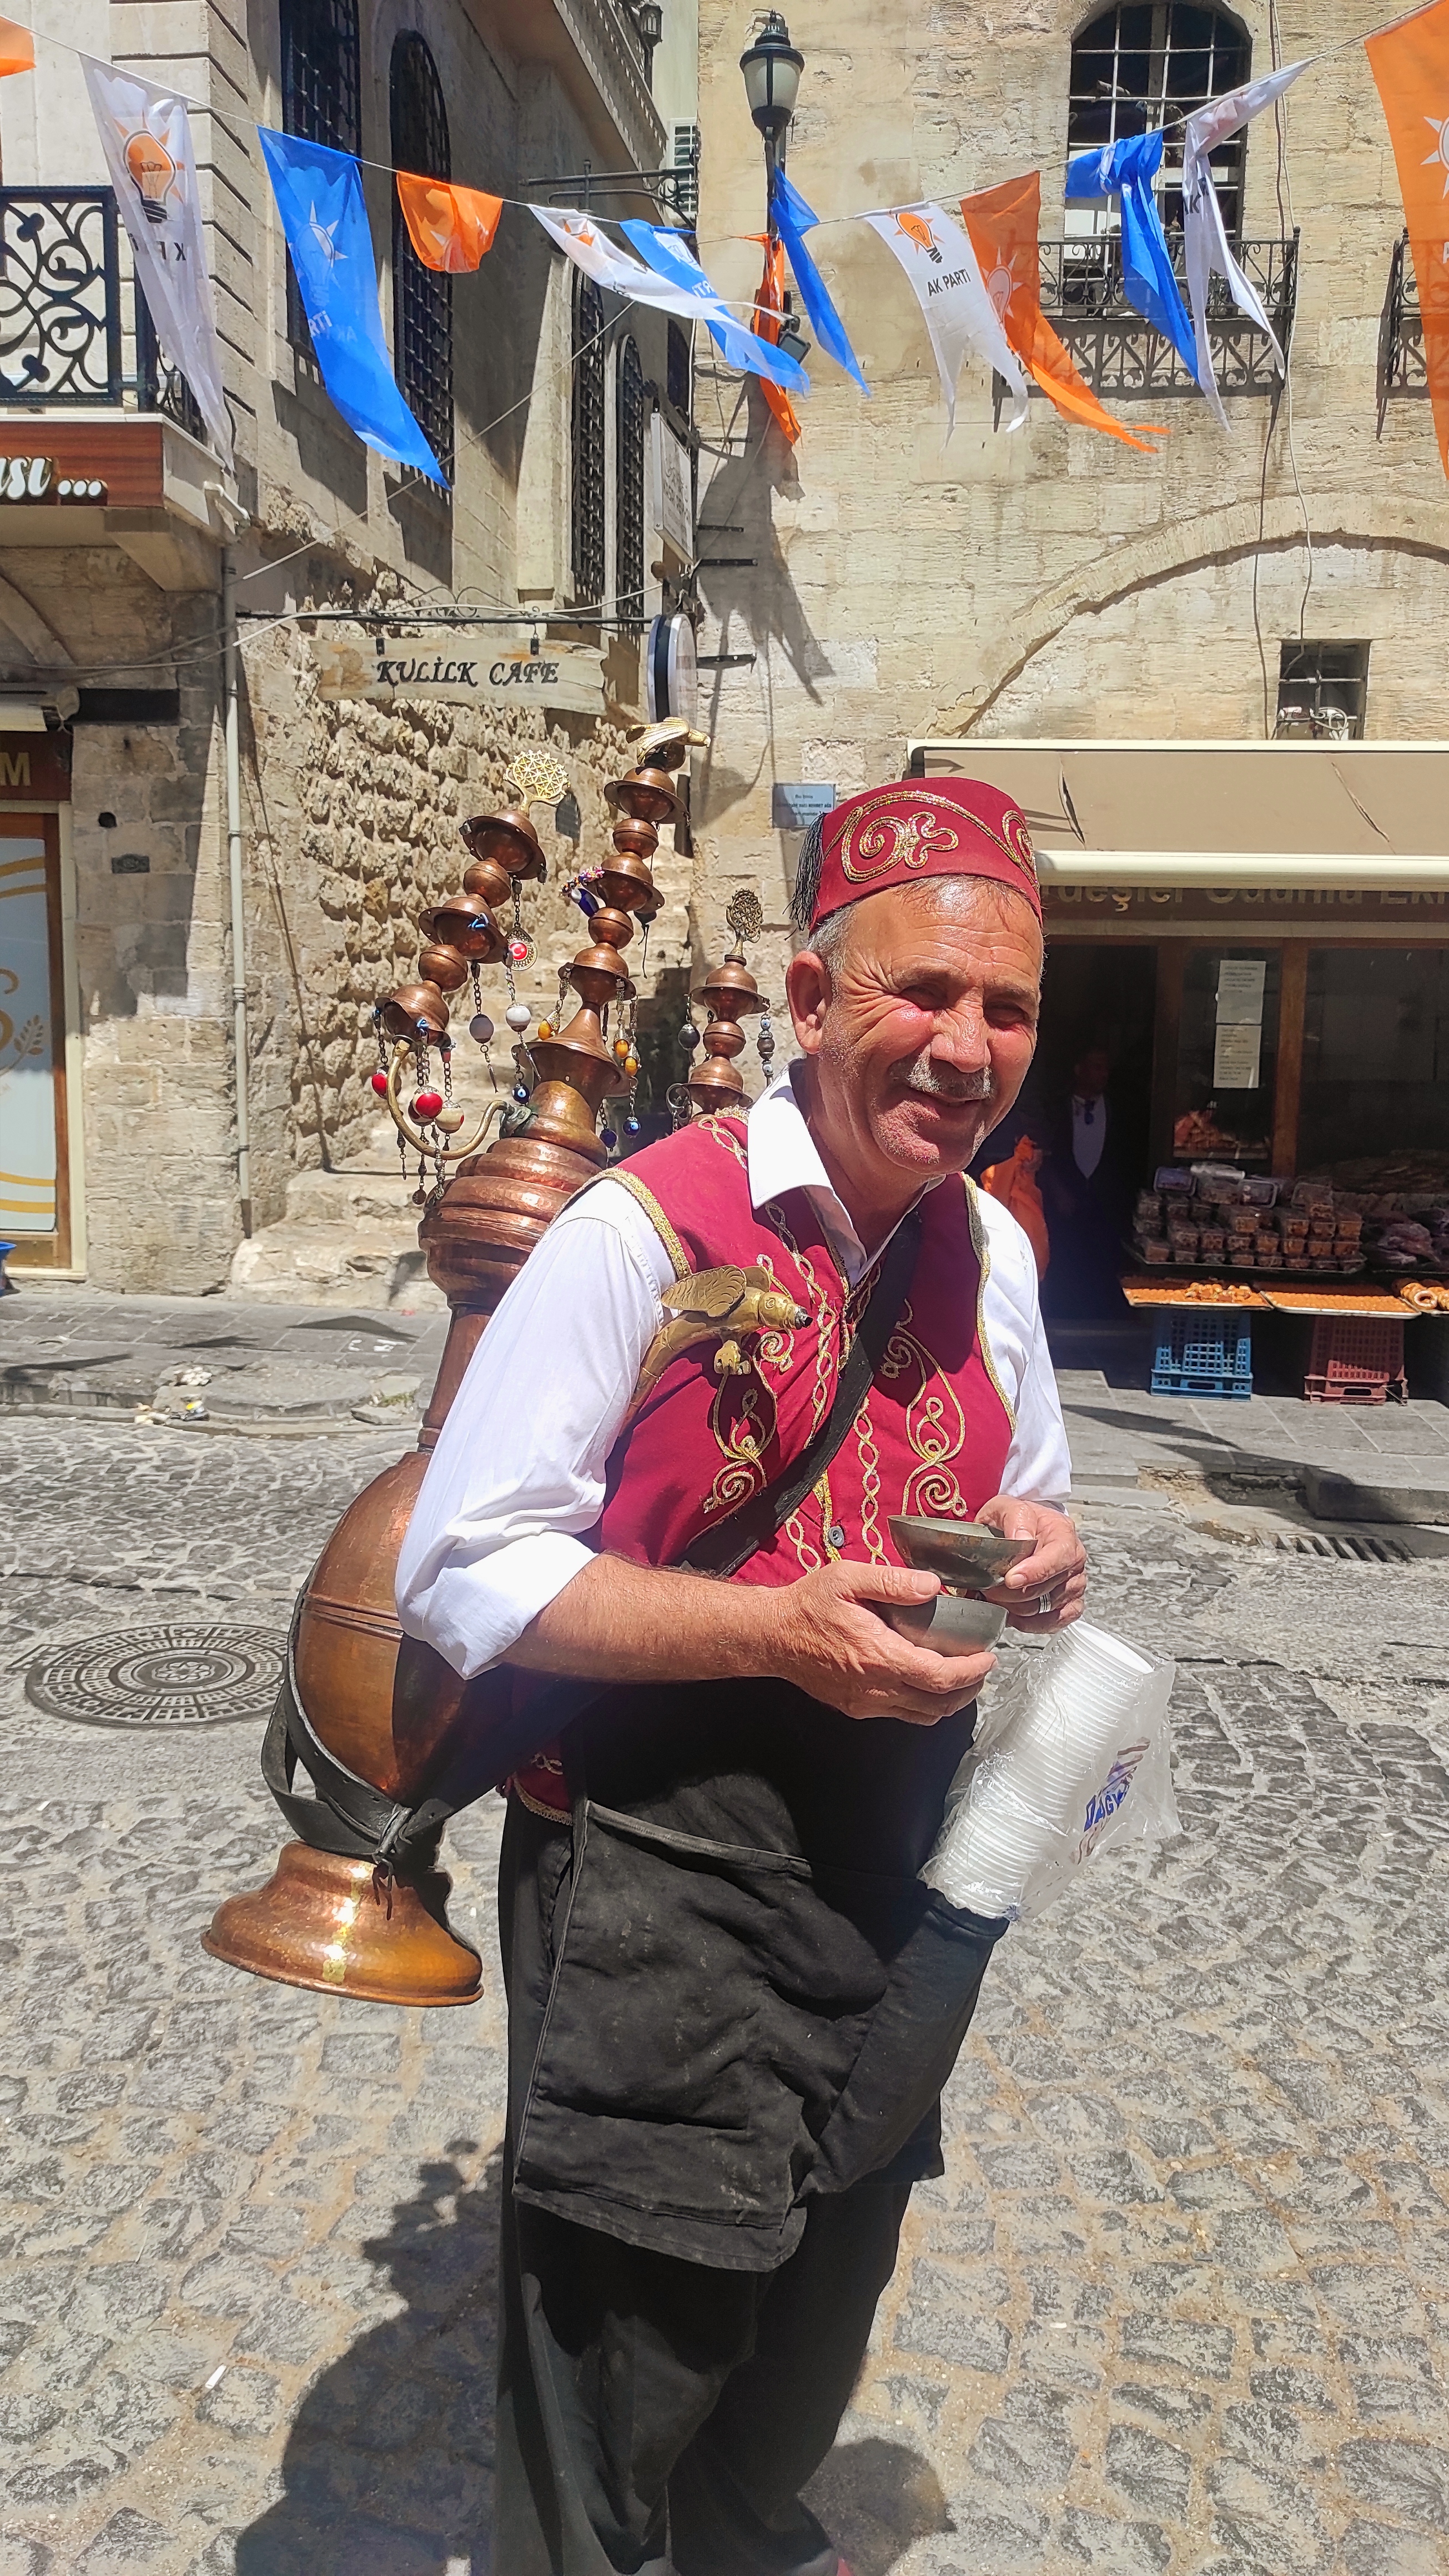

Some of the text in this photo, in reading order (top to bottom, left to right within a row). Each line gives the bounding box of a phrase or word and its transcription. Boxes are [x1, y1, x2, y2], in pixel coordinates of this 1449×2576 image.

[927, 278, 943, 297] AK
[376, 656, 560, 688] KULİLK CAFE
